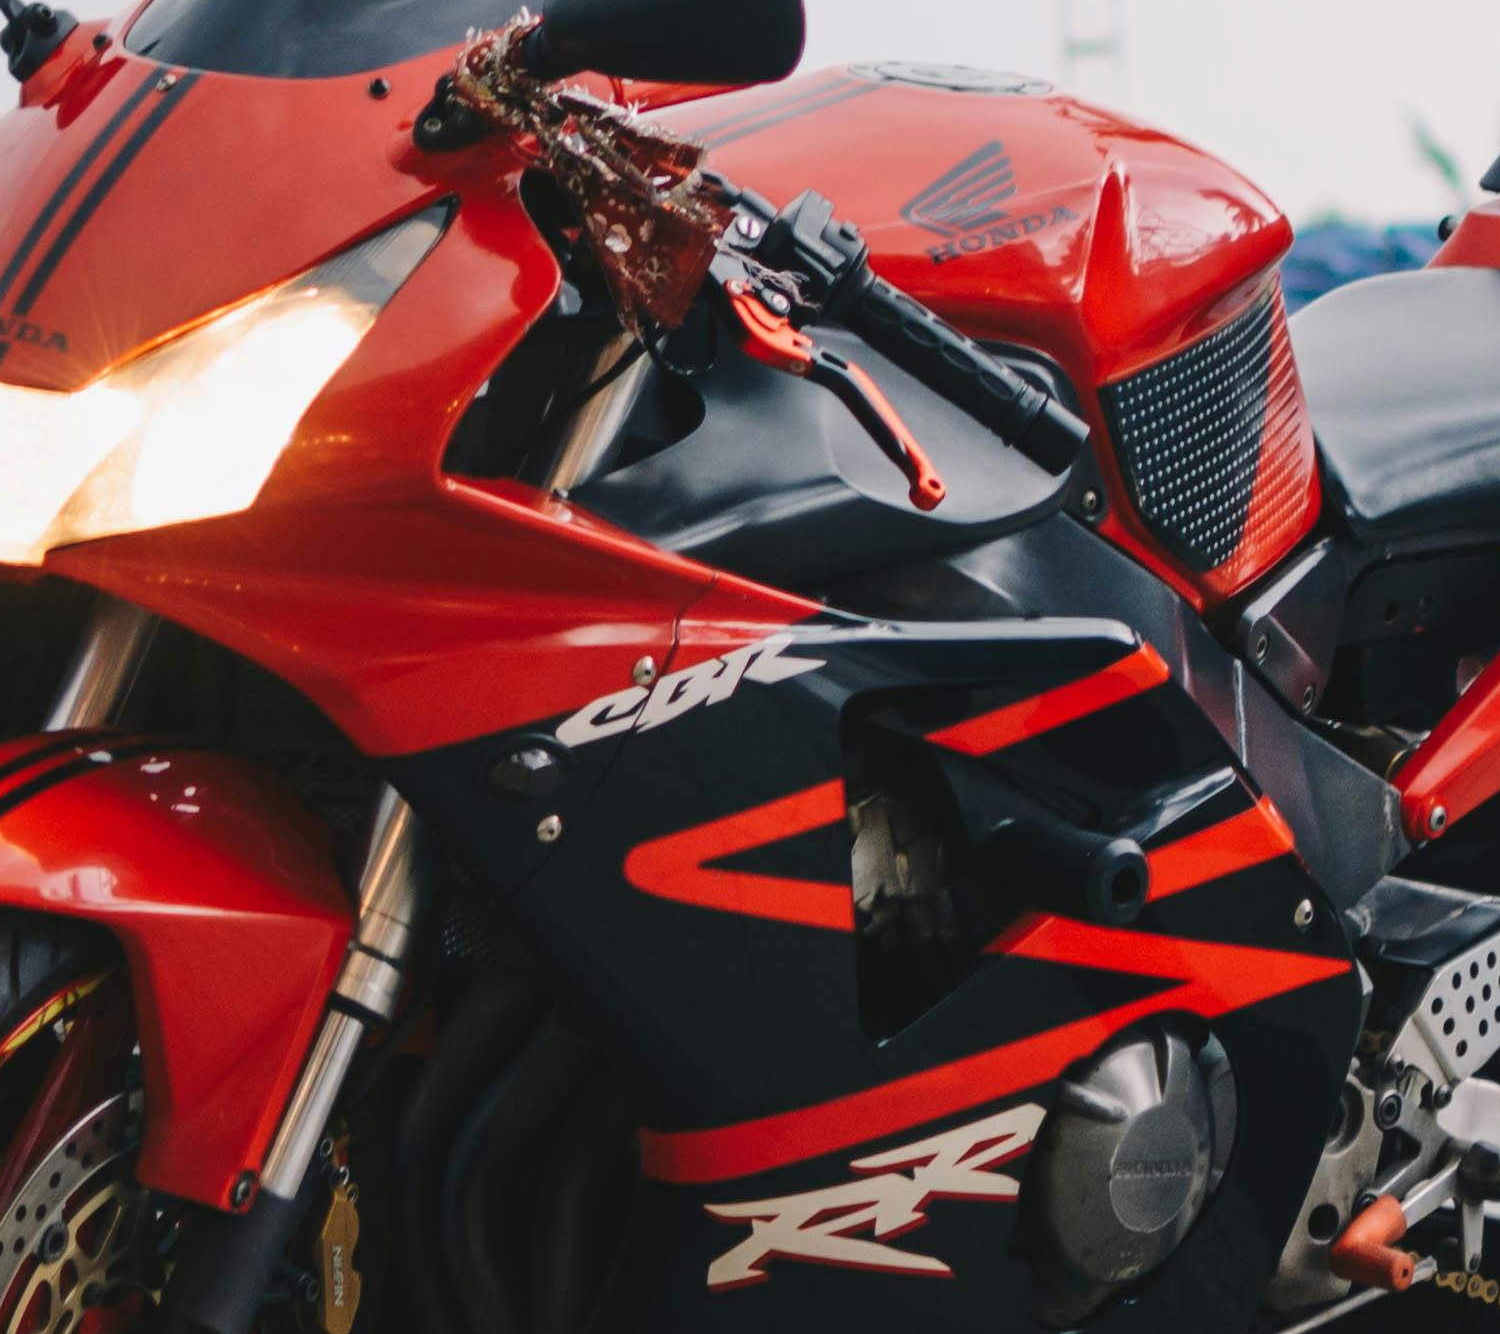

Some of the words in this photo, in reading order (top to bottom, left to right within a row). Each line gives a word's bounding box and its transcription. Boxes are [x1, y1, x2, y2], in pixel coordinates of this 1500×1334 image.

[926, 206, 1078, 263] HONDA
[555, 632, 828, 748] CBR
[703, 1101, 1047, 1293] RR
